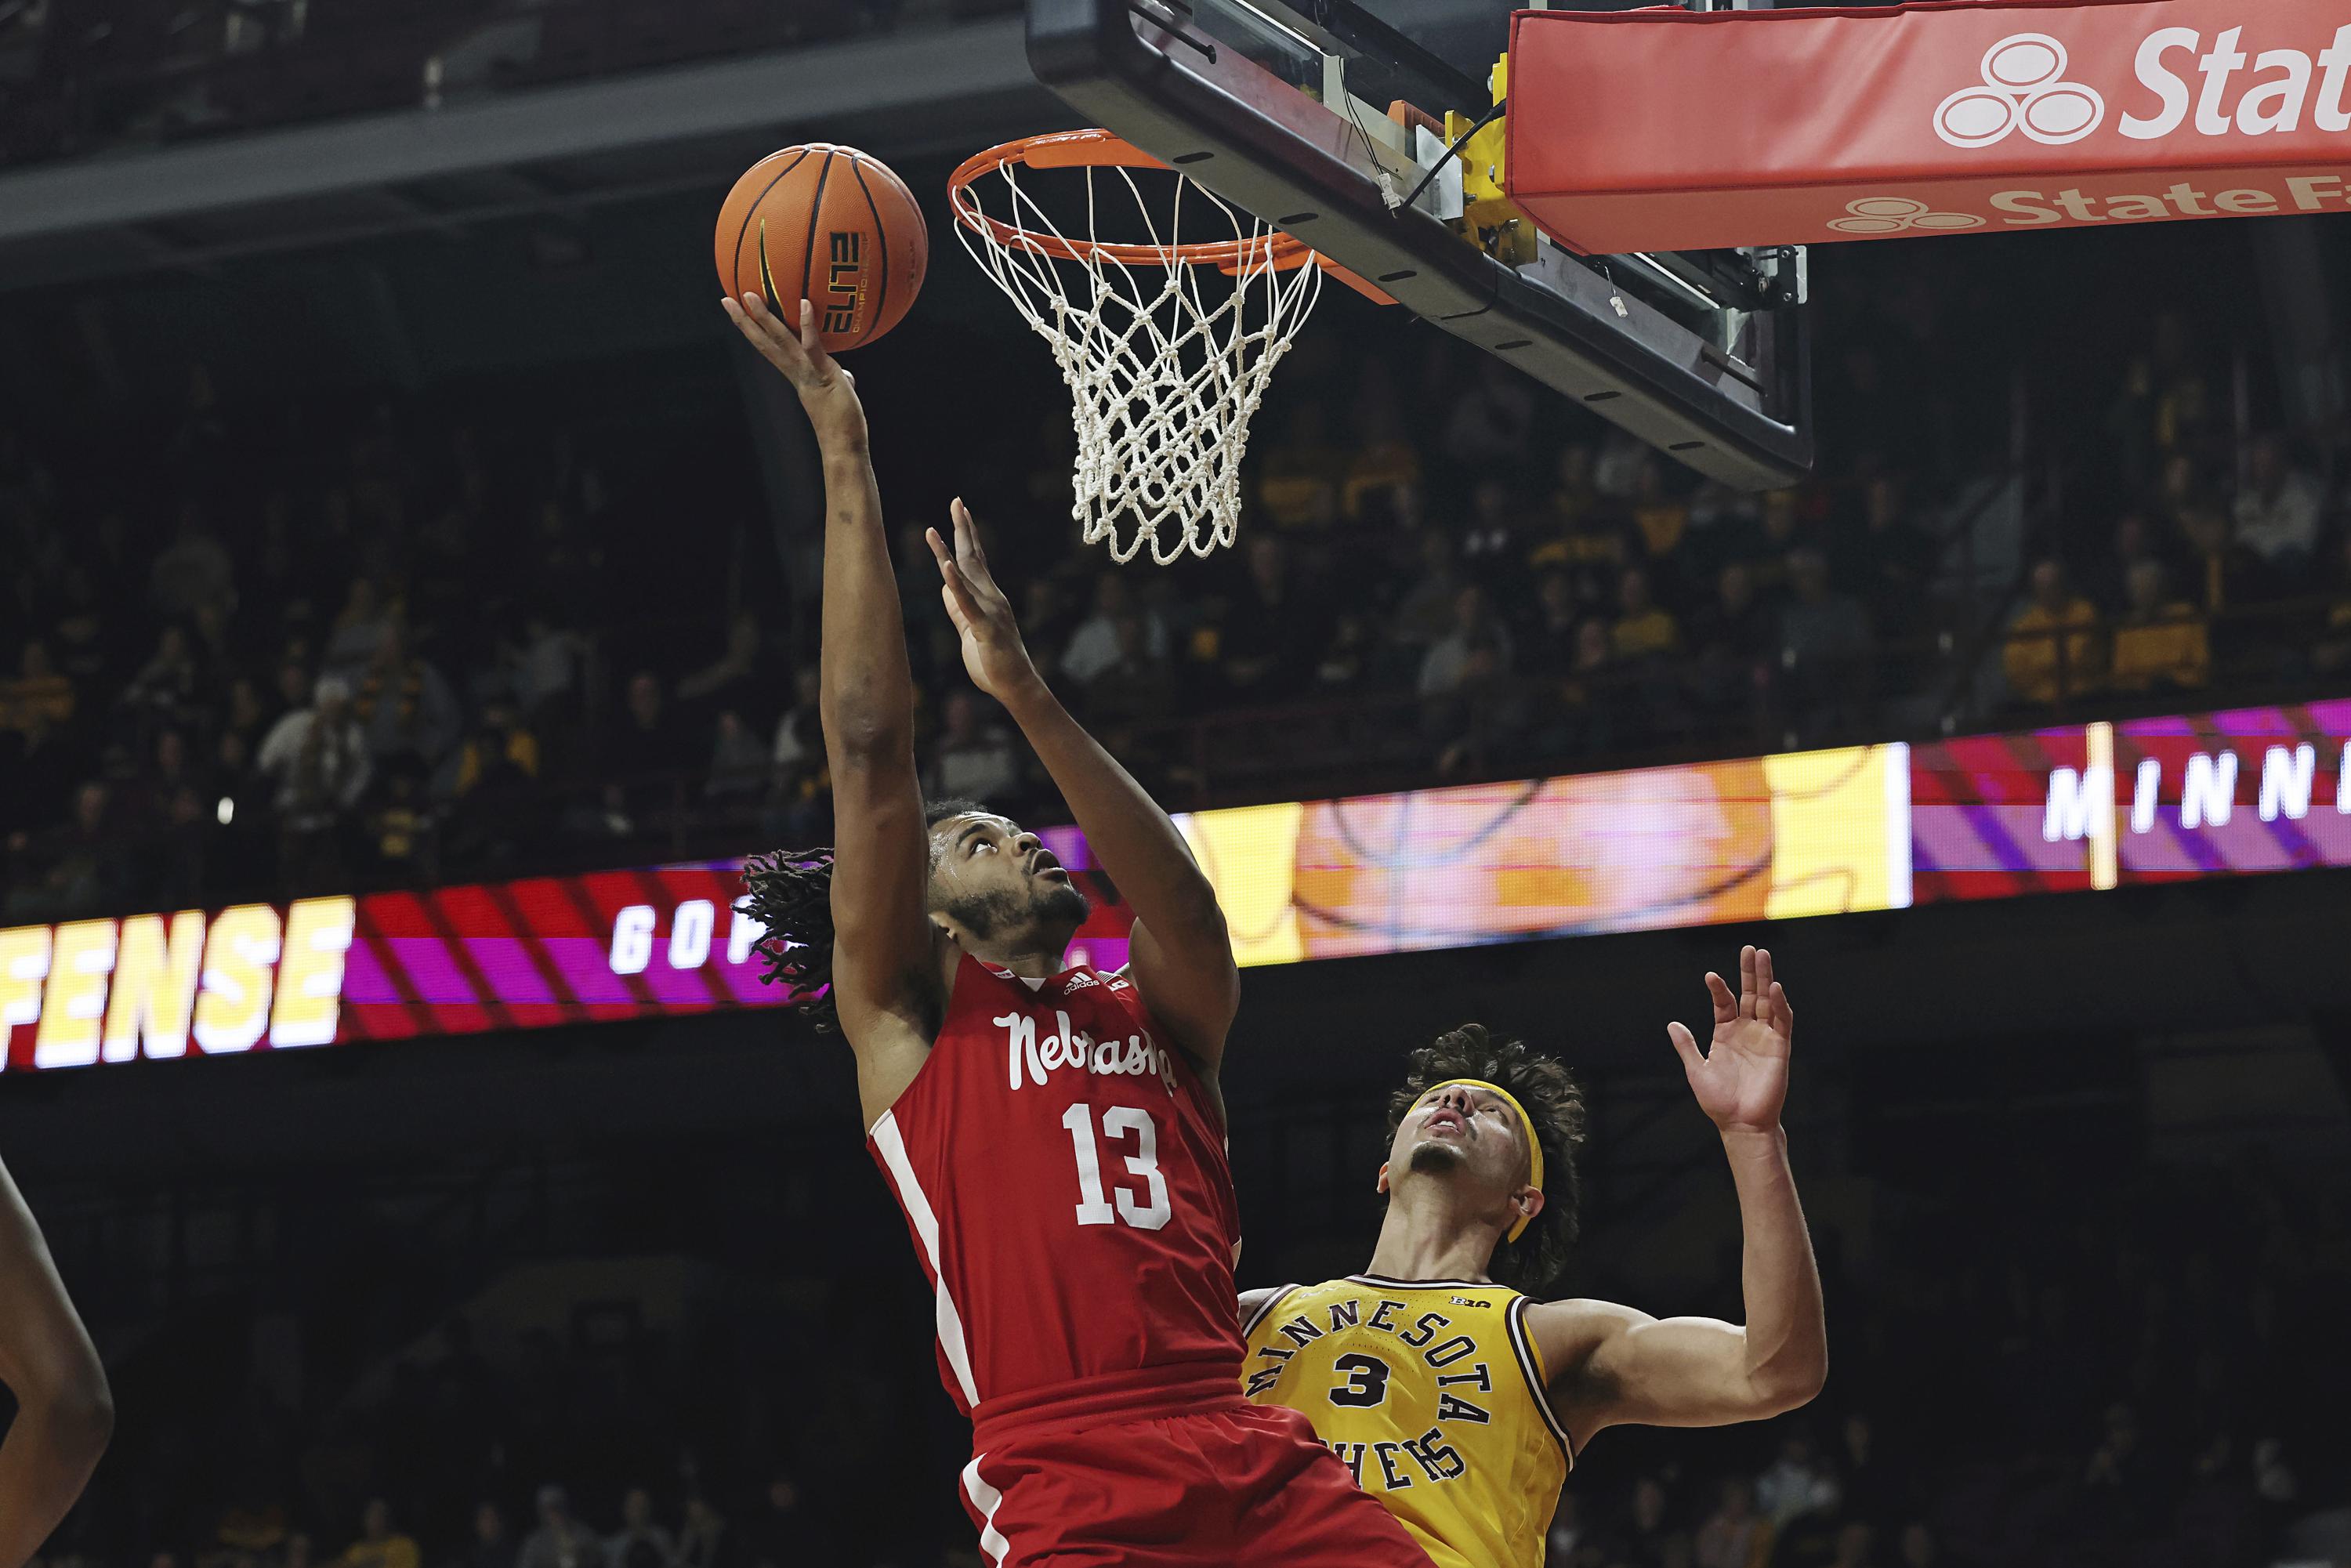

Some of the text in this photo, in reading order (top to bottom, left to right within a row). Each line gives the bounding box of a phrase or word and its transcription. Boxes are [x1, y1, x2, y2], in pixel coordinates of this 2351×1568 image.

[2117, 24, 2351, 139] Stat
[1989, 175, 2351, 225] State F
[823, 231, 860, 333] ELITE
[2043, 737, 2351, 842] MINN
[0, 894, 356, 1073] FENSE
[1063, 980, 1100, 995] adidas
[1062, 1103, 1172, 1231] 13
[1244, 1298, 1492, 1425] MINNESOTA
[1328, 1353, 1392, 1409] 3
[1318, 1426, 1466, 1492] HERS
